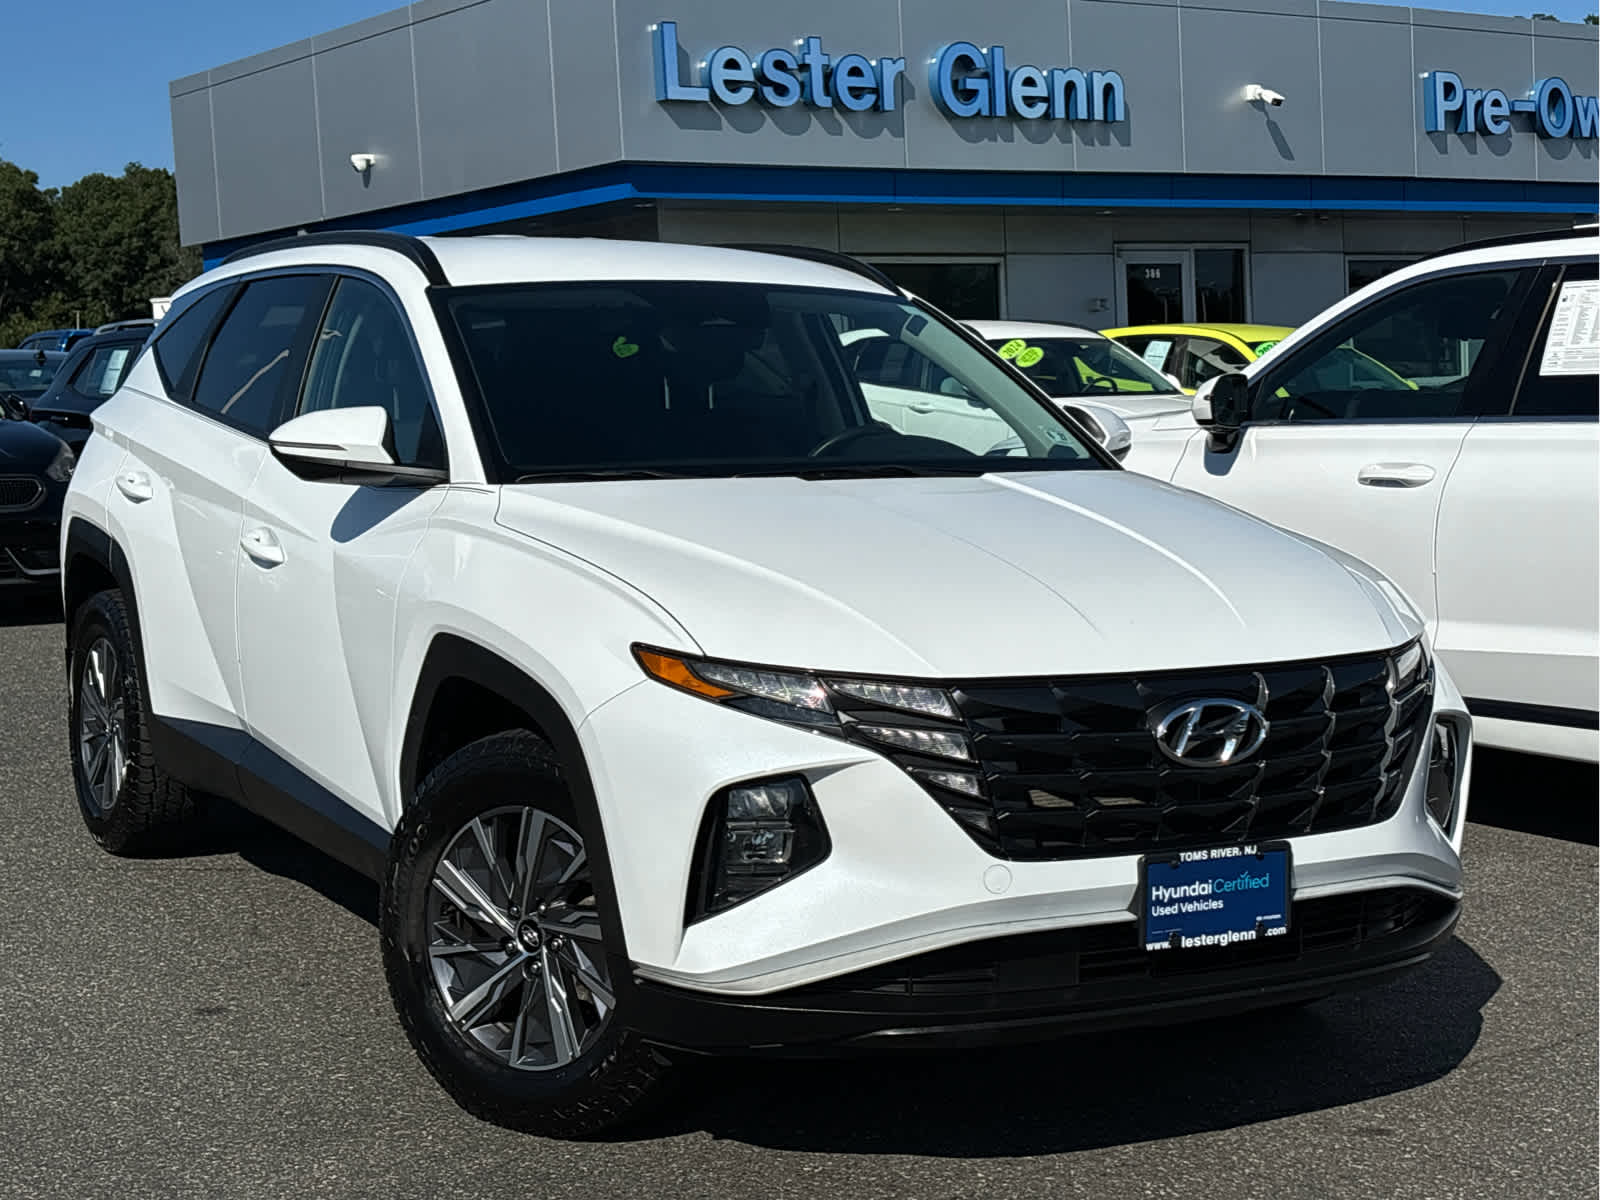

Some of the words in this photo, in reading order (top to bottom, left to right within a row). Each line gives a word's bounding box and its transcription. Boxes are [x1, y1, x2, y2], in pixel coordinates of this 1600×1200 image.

[653, 21, 905, 112] Lester
[929, 41, 1125, 121] Glenn
[1179, 850, 1208, 862] TOMS
[1152, 880, 1212, 903] Hyundai
[1213, 872, 1270, 893] Certified
[1151, 903, 1178, 917] Used
[1180, 899, 1224, 913] Vehicles
[1146, 941, 1171, 951] www.
[1181, 930, 1256, 948] lesterglenn
[1265, 926, 1287, 936] .com
